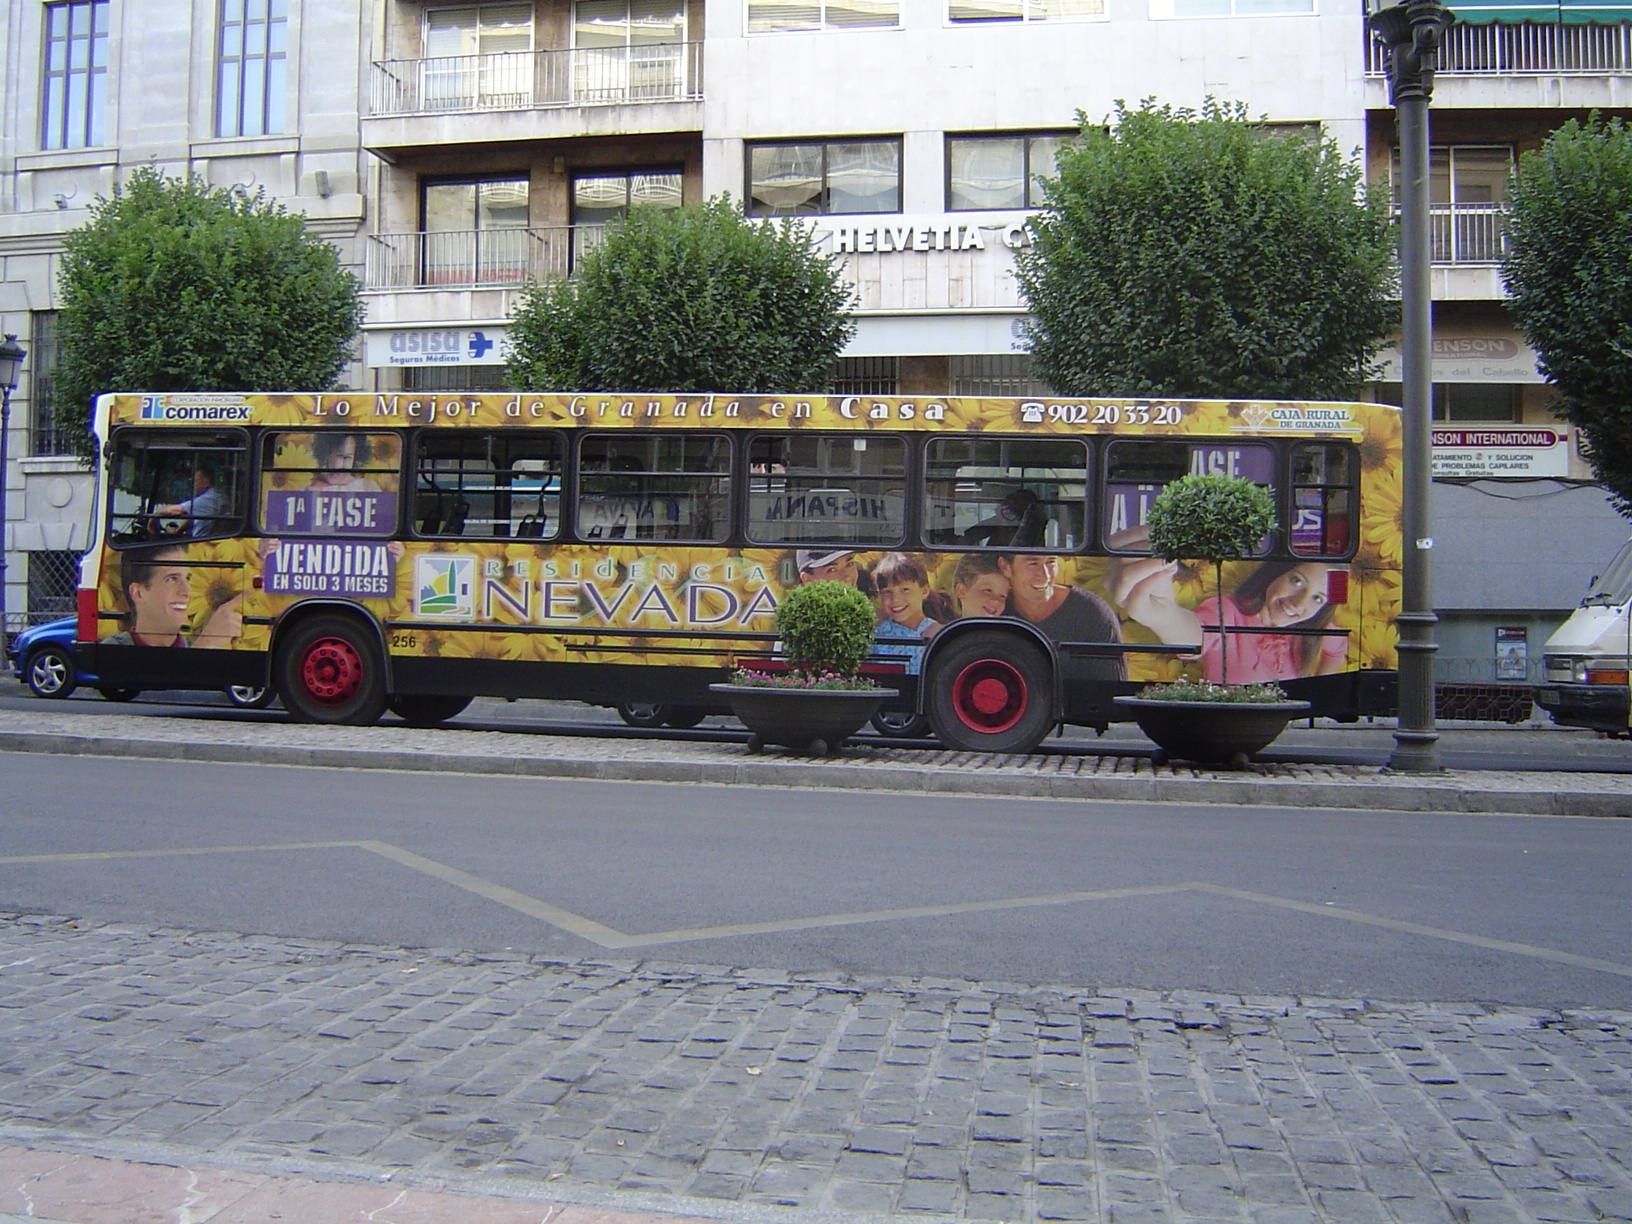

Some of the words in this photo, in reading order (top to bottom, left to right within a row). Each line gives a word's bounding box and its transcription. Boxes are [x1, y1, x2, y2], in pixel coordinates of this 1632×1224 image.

[832, 224, 985, 253] HELVETIA
[389, 331, 460, 352] asisa
[1432, 338, 1506, 352] ENSON
[389, 355, 423, 364] Seguros
[426, 353, 460, 363] Médicos
[1451, 367, 1471, 377] del
[1482, 366, 1528, 377] Cabello
[165, 405, 249, 420] comarex
[314, 395, 351, 417] Lo
[375, 395, 482, 423] Mejor
[506, 395, 545, 417] de
[569, 395, 740, 418] Granada
[771, 401, 812, 418] en
[840, 397, 948, 420] Casa
[1047, 404, 1088, 424] 902
[1091, 405, 1120, 425] 20
[1123, 405, 1150, 425] 33
[1152, 405, 1183, 426] 20
[1271, 409, 1301, 420] CAJA
[1306, 410, 1350, 421] RURAL
[1295, 421, 1342, 429] GRANADA
[1432, 433, 1461, 444] NSON
[1465, 433, 1551, 444] INTERNATIONAL
[1190, 450, 1240, 479] ASE
[315, 497, 377, 528] FASE
[273, 574, 289, 589] EN
[294, 575, 328, 591] SOLO
[332, 577, 340, 592] 3
[345, 576, 389, 593] MESES
[486, 580, 778, 624] NEVADA
[392, 636, 416, 648] 256
